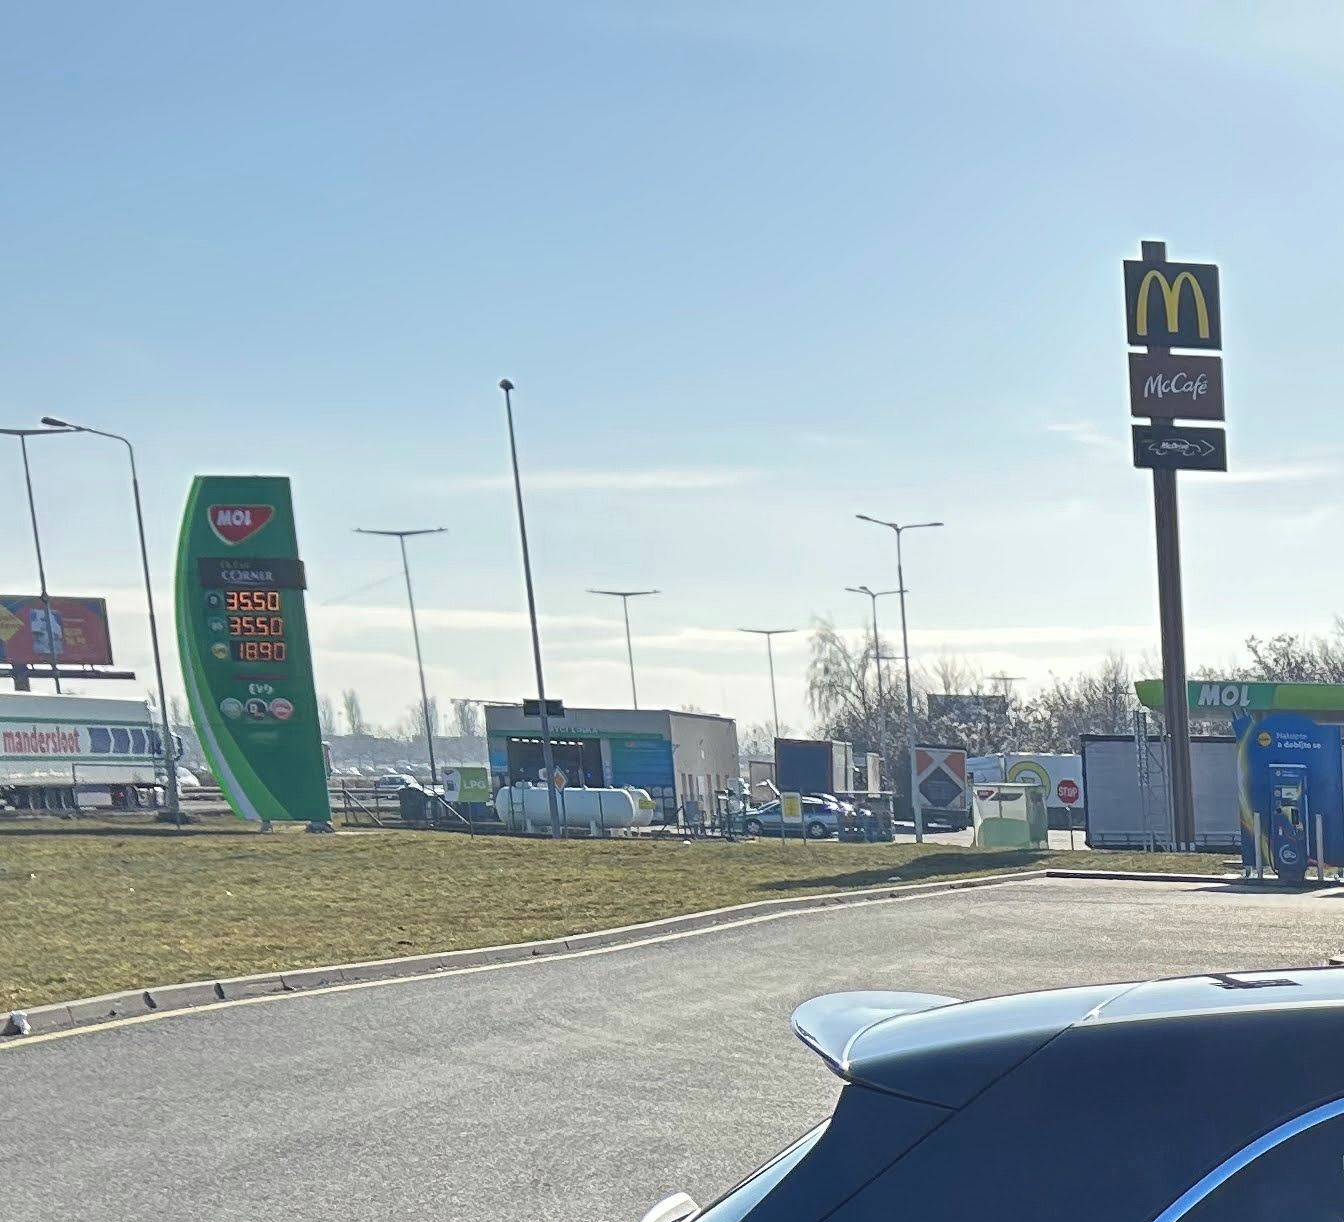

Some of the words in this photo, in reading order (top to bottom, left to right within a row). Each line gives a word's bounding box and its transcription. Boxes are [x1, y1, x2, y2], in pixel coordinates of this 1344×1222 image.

[1144, 371, 1209, 400] McCafé
[1198, 685, 1251, 707] MOL
[3, 725, 81, 753] mandersloot
[463, 780, 487, 790] LPG
[1058, 786, 1078, 797] STOP
